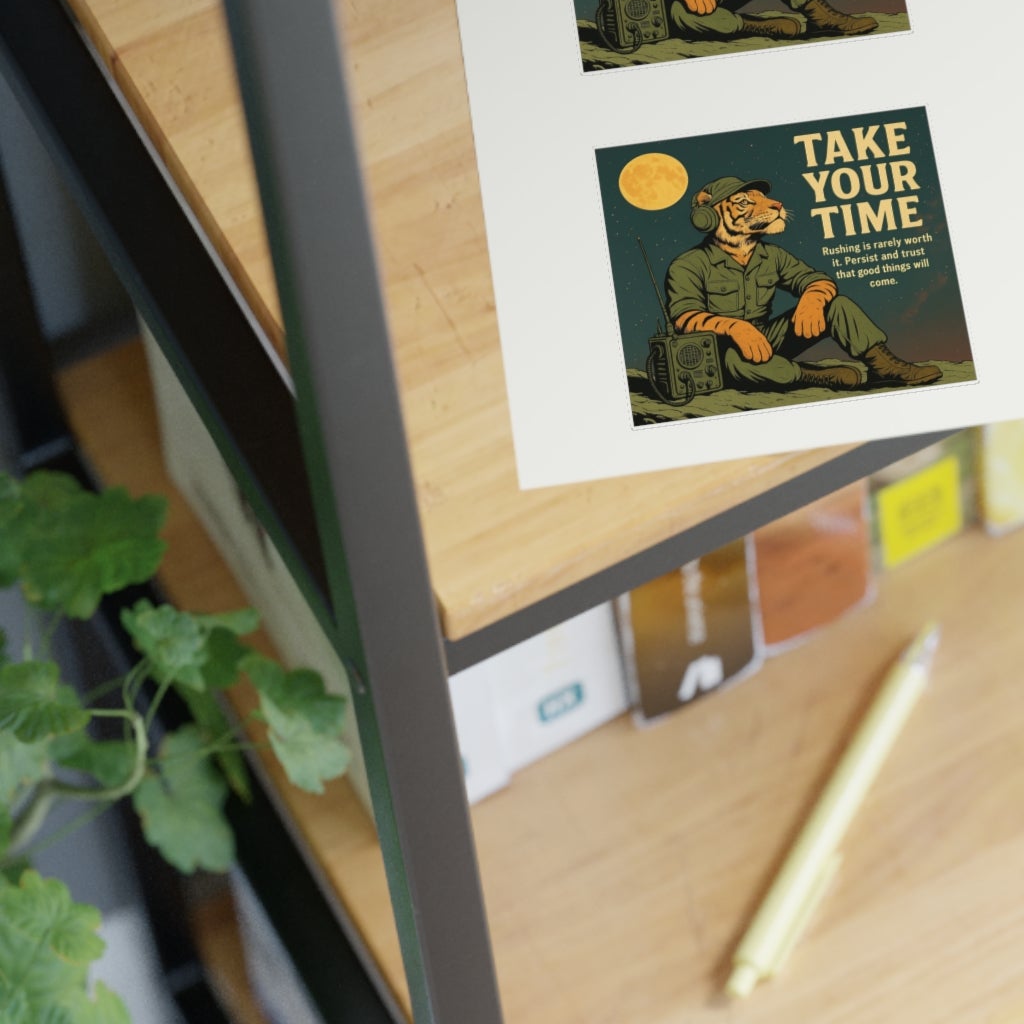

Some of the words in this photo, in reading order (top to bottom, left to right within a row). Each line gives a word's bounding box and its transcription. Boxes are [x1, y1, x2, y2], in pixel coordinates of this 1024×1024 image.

[793, 122, 910, 167] TAKE
[802, 160, 921, 202] YOUR
[811, 195, 923, 239] TIME
[822, 243, 861, 256] Rushing
[863, 242, 871, 250] is
[874, 238, 901, 249] rarely
[904, 233, 933, 244] worth
[832, 258, 842, 267] it.
[845, 254, 878, 265] Persist
[881, 250, 898, 260] and
[902, 247, 925, 257] trust
[836, 270, 855, 279] that
[858, 265, 880, 278] good
[883, 262, 911, 273] things
[914, 259, 930, 269] will
[870, 277, 898, 287] come.
